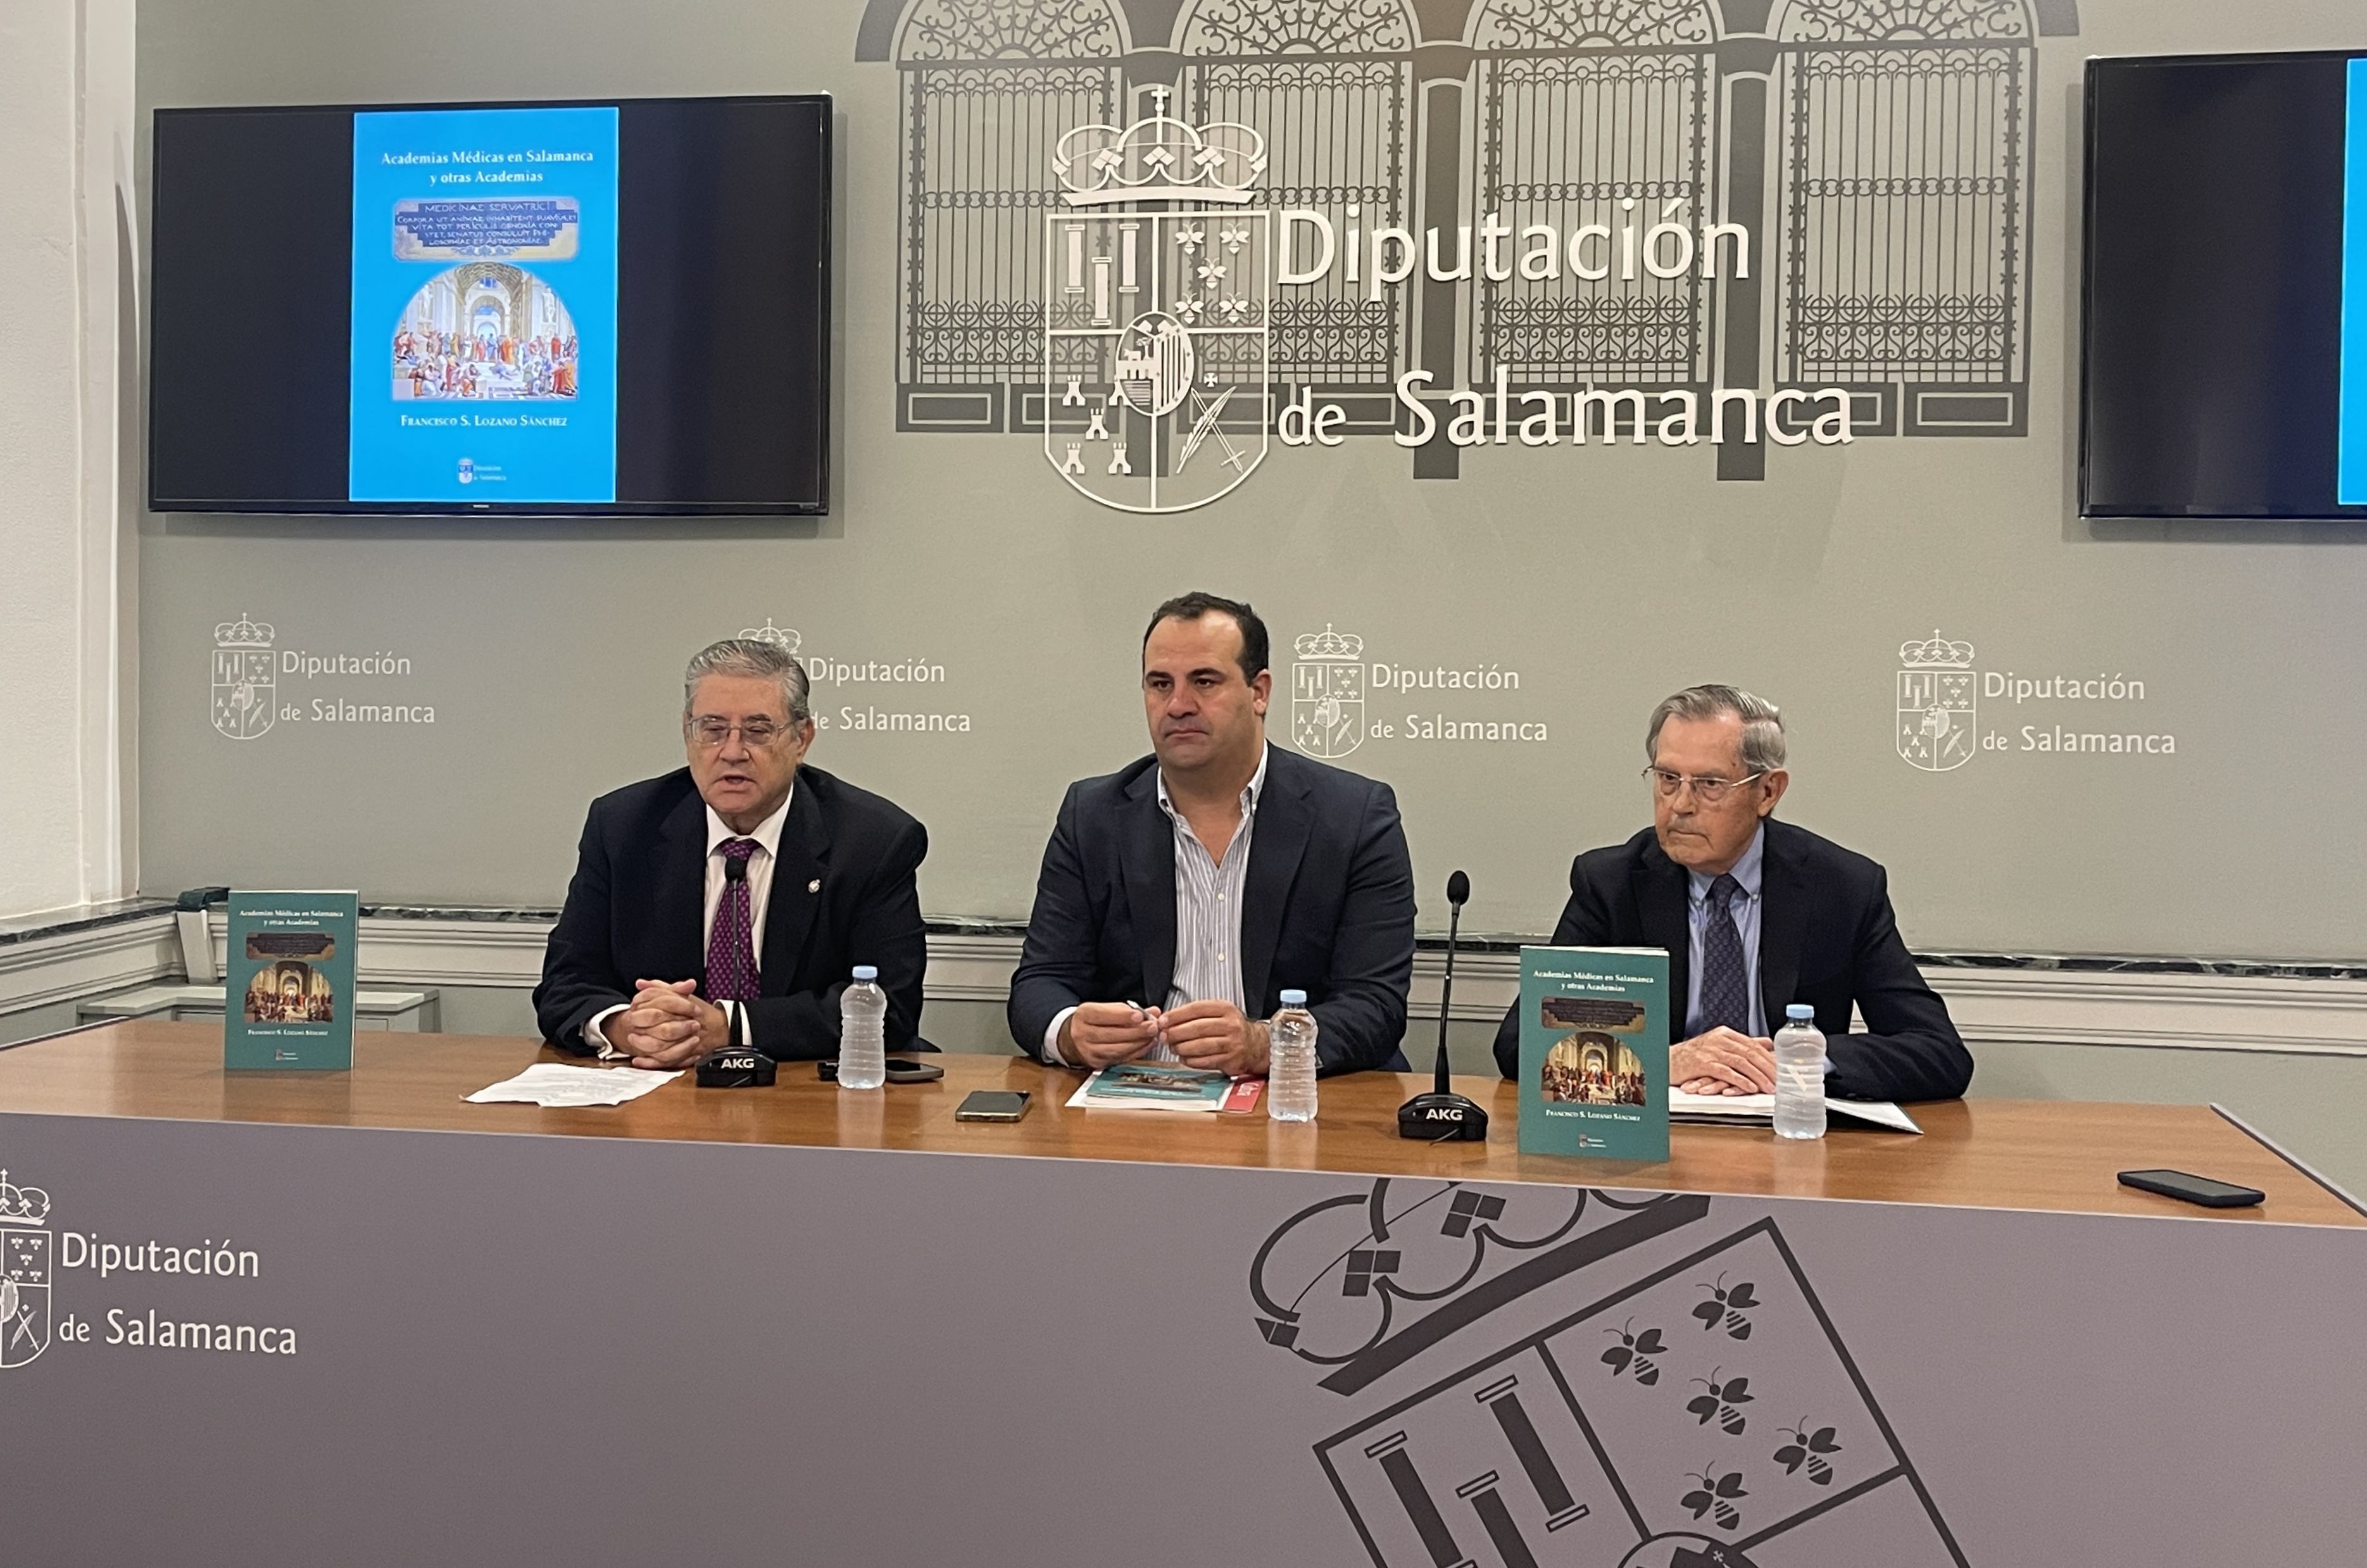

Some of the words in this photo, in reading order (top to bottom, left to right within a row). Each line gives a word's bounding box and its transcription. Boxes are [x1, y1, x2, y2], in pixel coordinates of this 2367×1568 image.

[382, 152, 448, 165] Academias
[452, 151, 504, 163] Médicas
[507, 153, 522, 162] en
[526, 149, 593, 162] Salamanca
[430, 174, 437, 187] y
[441, 173, 472, 183] otras
[475, 170, 543, 183] Academias
[489, 202, 549, 211] SERVATRICI
[1276, 198, 1750, 302] Diputación
[1278, 385, 1346, 447] de
[1395, 365, 1855, 448] Salamanca
[401, 415, 457, 427] FRANCISCO
[460, 415, 471, 427] S.
[475, 415, 517, 427] LOZANO
[520, 415, 568, 427] SÁNCHEZ
[282, 650, 411, 679] Diputación
[809, 656, 945, 687] Diputación
[1372, 663, 1519, 694] Diputación
[1984, 672, 2144, 704] Diputación
[280, 703, 301, 721] de
[310, 698, 435, 723] Salamanca
[839, 706, 970, 732] Salamanca
[1370, 719, 1394, 739] de
[1405, 713, 1547, 741] Salamanca
[1982, 731, 2008, 751] de
[2021, 725, 2176, 754] Salamanca
[1533, 970, 1572, 979] Academias
[1615, 974, 1654, 983] Salamanca
[1586, 982, 1626, 992] Academias
[720, 1058, 755, 1069] AKG
[1426, 1108, 1463, 1120] AKG
[62, 1231, 259, 1279] Diputación
[59, 1313, 90, 1342] de
[105, 1308, 297, 1355] Salamanca
